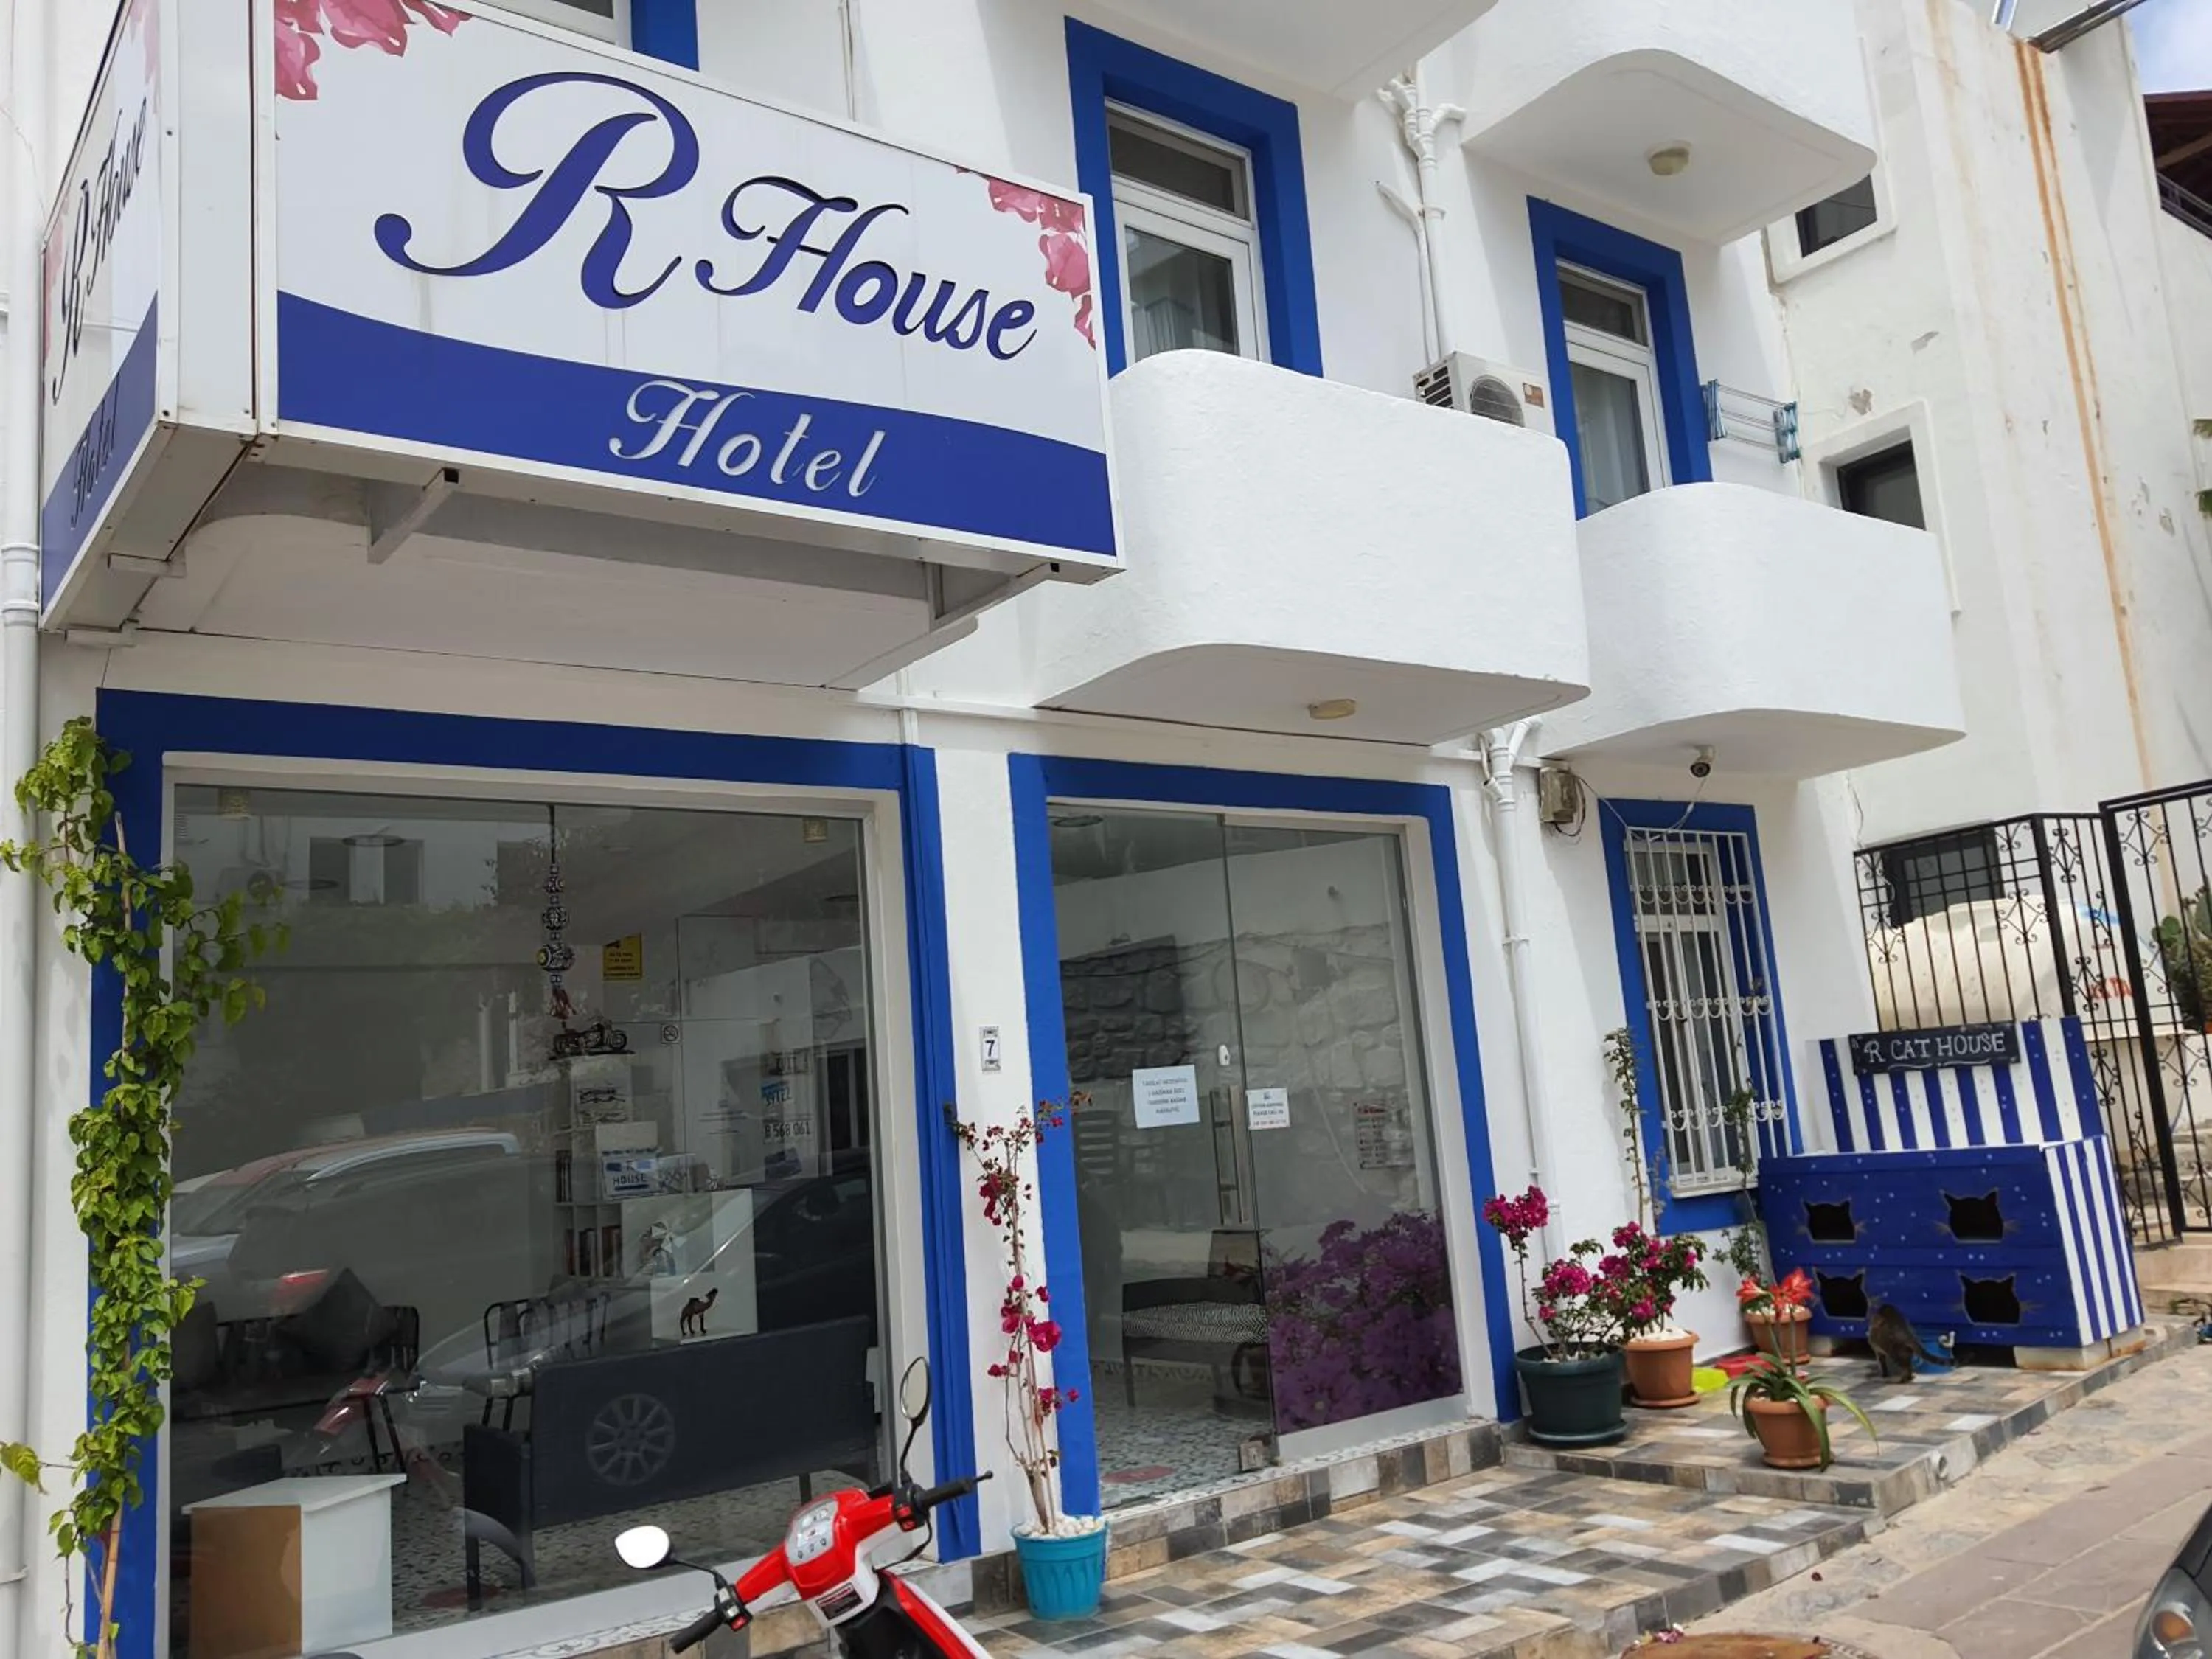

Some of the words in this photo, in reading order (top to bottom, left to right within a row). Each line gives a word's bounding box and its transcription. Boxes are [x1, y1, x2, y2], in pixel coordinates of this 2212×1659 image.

[374, 72, 700, 309] R
[694, 175, 1037, 361] House
[52, 178, 89, 406] R
[608, 380, 886, 498] Hotel
[985, 1040, 995, 1057] 7
[1863, 1040, 1886, 1062] R
[1890, 1038, 1931, 1060] CAT
[1935, 1032, 2006, 1057] HOUSE
